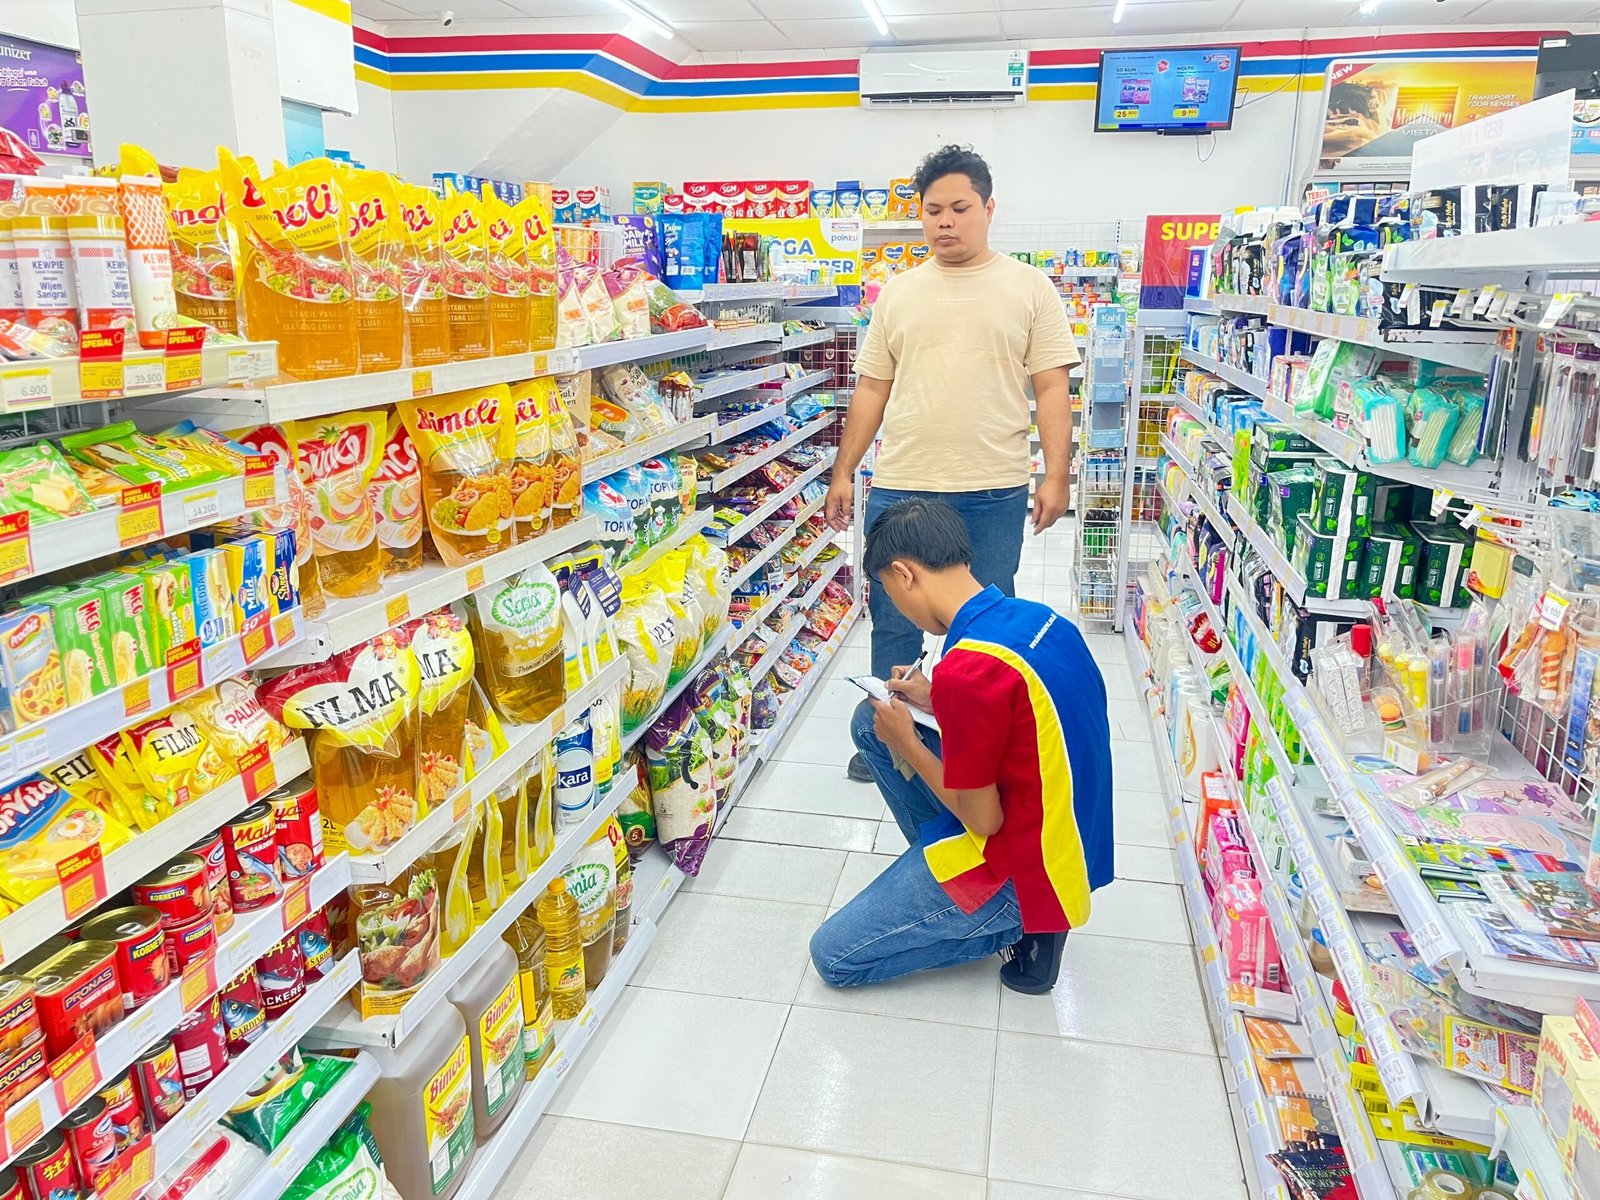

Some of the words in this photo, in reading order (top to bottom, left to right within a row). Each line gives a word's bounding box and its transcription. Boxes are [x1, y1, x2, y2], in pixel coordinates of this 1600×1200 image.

[1330, 63, 1353, 80] NEW
[1395, 100, 1453, 126] Marlboro
[691, 184, 707, 194] SGM
[721, 184, 739, 194] SGM
[754, 183, 768, 192] SGM
[784, 183, 799, 192] SGM
[31, 260, 65, 270] KEWPIE
[143, 253, 171, 265] KEWP
[39, 281, 63, 291] Wijen
[36, 289, 67, 299] Sangrai
[187, 306, 217, 316] STABIL
[1101, 313, 1121, 322] Kahf
[82, 338, 113, 349] SPESIAL
[168, 336, 195, 345] SPESIAL
[21, 384, 48, 396] 6.900
[416, 397, 501, 436] Bimoli
[247, 462, 268, 470] SPESIAL
[650, 482, 671, 493] TOPI
[124, 492, 153, 505] SPESIAL
[125, 585, 144, 615] MEG
[198, 570, 209, 618] CHEDDAR
[246, 576, 257, 611] Mild
[78, 599, 101, 632] MEG
[10, 616, 40, 646] Prochiz
[168, 648, 193, 664] SPESIAL
[295, 670, 409, 729] FILMA
[240, 754, 263, 772] SPESIAL
[322, 818, 337, 830] 2L
[631, 831, 639, 841] 5
[249, 839, 274, 854] SARDEN
[60, 857, 93, 879] SPESIAL
[65, 968, 113, 1011] PRONAS
[485, 983, 517, 1033] Bimoli
[52, 1048, 86, 1079] SPESIAL
[429, 1044, 466, 1105] Bimoli
